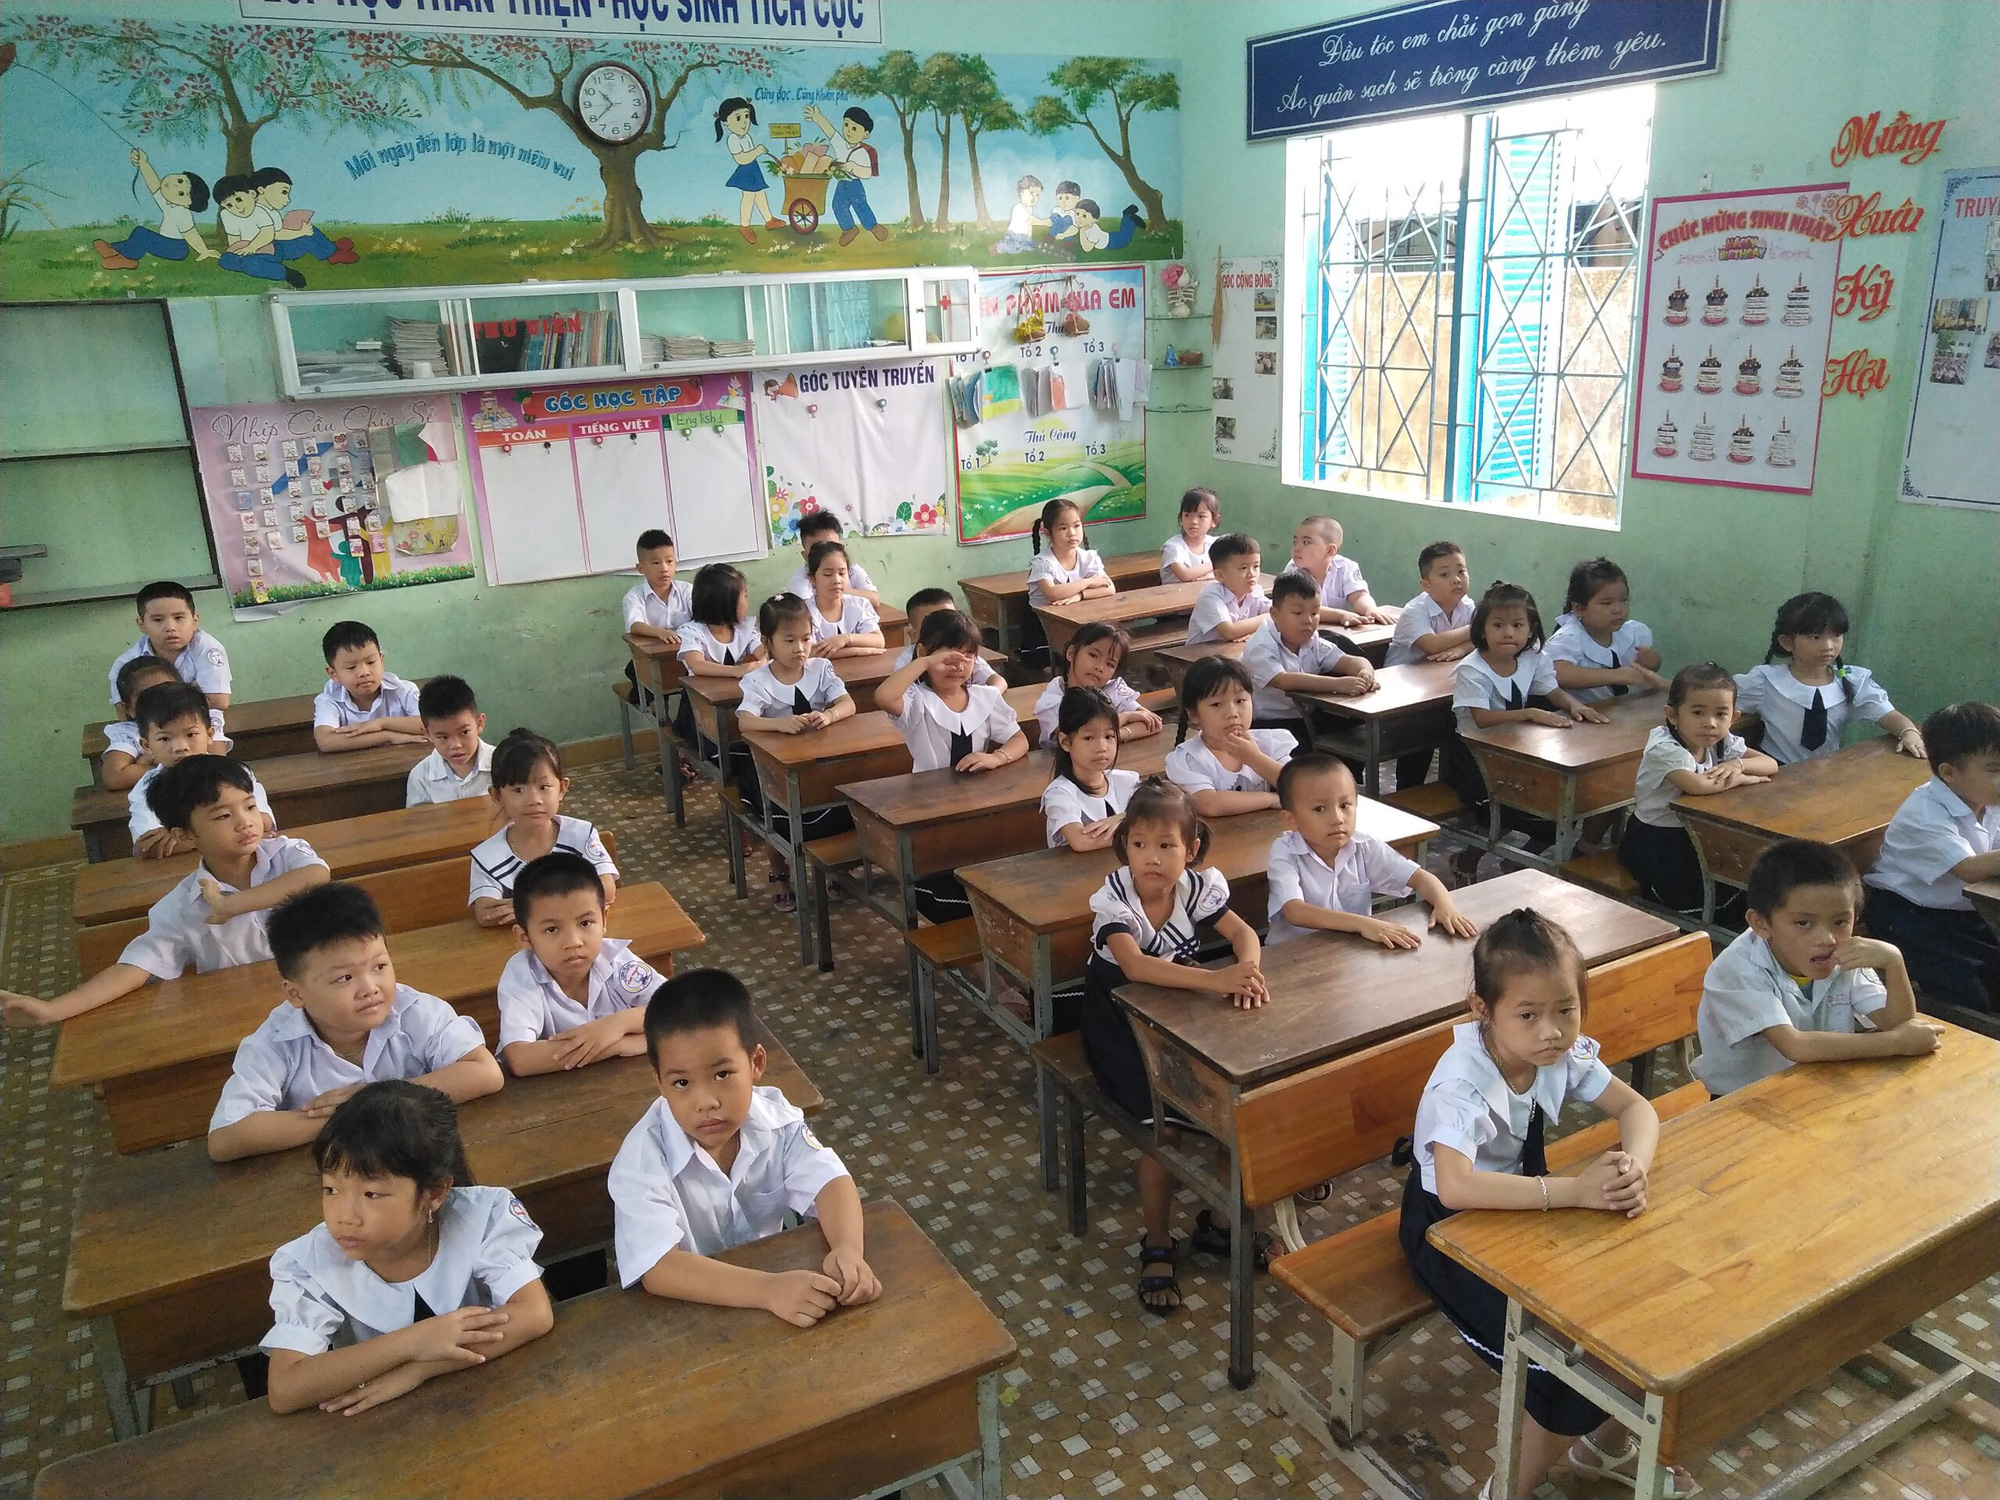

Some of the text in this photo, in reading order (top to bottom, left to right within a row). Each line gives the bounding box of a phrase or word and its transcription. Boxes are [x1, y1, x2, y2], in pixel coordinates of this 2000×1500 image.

[1318, 0, 1591, 67] Đầu tóc em chải gọn gàng
[593, 76, 601, 85] 11
[603, 72, 615, 80] 12
[1310, 83, 1356, 119] quần
[1360, 69, 1398, 102] sạch
[1403, 69, 1422, 92] sẽ
[1429, 64, 1480, 95] trông
[1487, 55, 1537, 85] càng
[1545, 37, 1604, 67] thêm
[1609, 31, 1667, 70] yêu.
[584, 87, 596, 96] 10
[627, 84, 637, 93] 2
[583, 100, 592, 109] 9
[632, 98, 641, 107] 3
[589, 114, 597, 123] 8
[630, 112, 639, 120] 4
[599, 123, 607, 132] 7
[611, 126, 620, 135] 6
[623, 122, 632, 131] 5
[1830, 110, 1947, 168] Mừng
[344, 149, 378, 181] Mỗi
[378, 140, 416, 168] ngày
[415, 131, 441, 154] đến
[445, 132, 467, 156] lớp
[472, 132, 486, 153] là
[517, 147, 551, 171] niềm
[552, 160, 576, 182] vui
[1955, 196, 2000, 218] TRUY
[1658, 218, 1701, 250] CHÚC
[1749, 209, 1790, 232] SINH
[1788, 212, 1837, 242] NHẬT
[1236, 270, 1253, 291] CỘNG
[1108, 287, 1136, 309] EM
[1035, 345, 1042, 357] 2
[1083, 338, 1105, 353] Tổ 3
[799, 370, 829, 393] GÓC
[832, 366, 879, 390] TUYÊN
[544, 384, 682, 413] GÓC HỌC TẬP
[212, 413, 279, 445] Nhịp
[285, 409, 336, 436] Cầu
[341, 405, 397, 431] Chia
[578, 418, 651, 435] TIẾNG VIỆT
[501, 428, 548, 442] TOÁN
[1049, 428, 1077, 441] Công
[1025, 448, 1045, 463] Tổ 2
[1086, 441, 1106, 456] Tổ 3
[961, 455, 980, 470] Tổ 1
